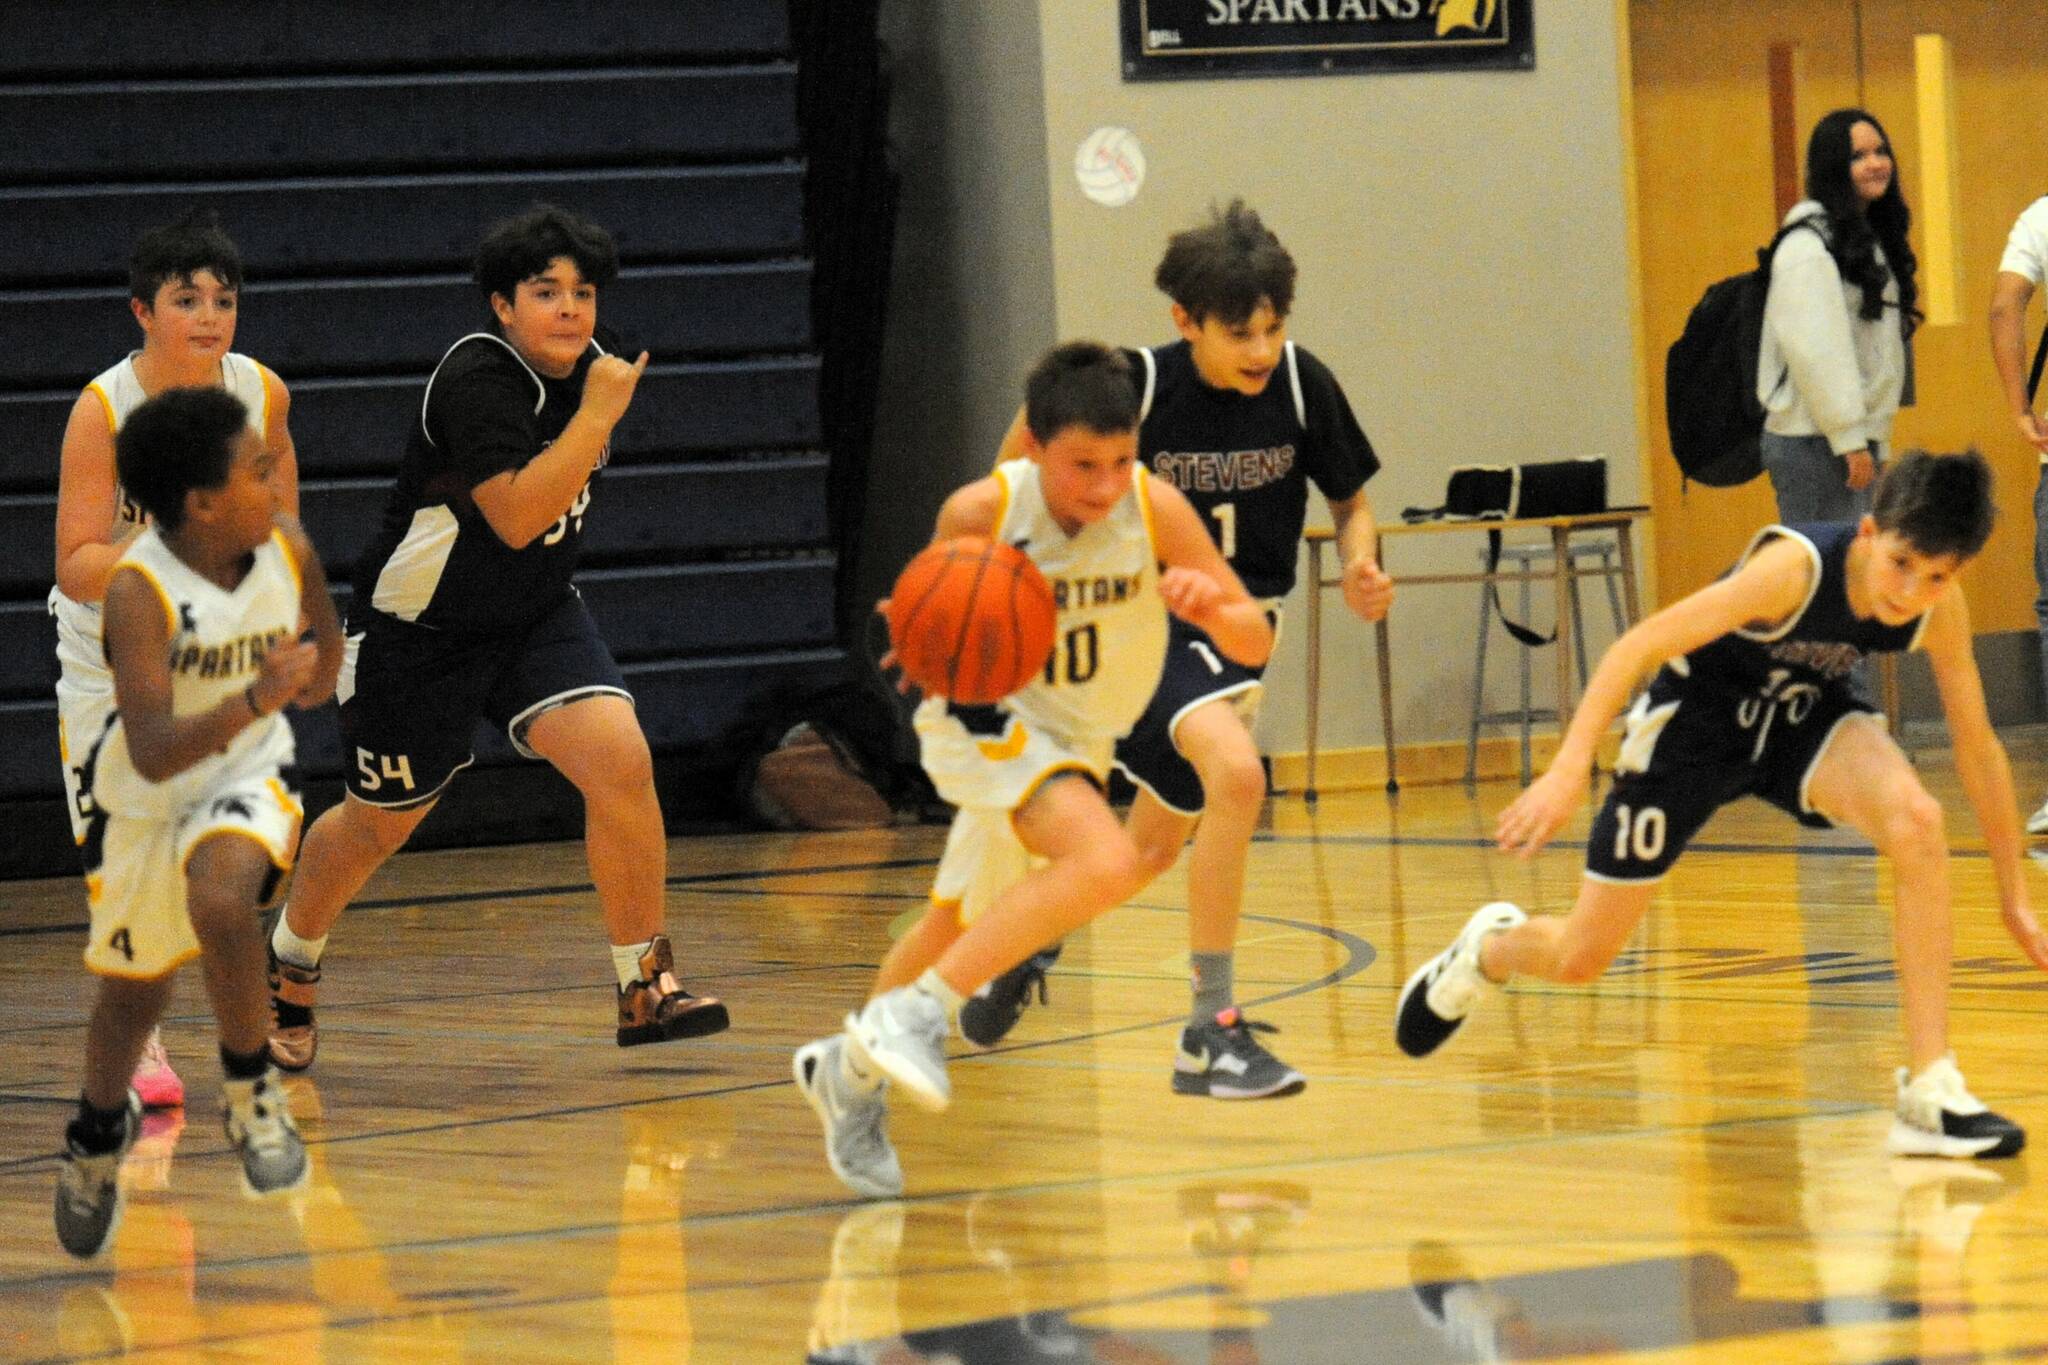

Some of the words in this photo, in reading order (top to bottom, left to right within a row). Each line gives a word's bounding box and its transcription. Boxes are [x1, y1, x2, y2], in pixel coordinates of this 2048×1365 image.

[1153, 443, 1295, 492] STEVENS
[1211, 503, 1236, 559] 1
[1188, 640, 1224, 676] 1
[356, 745, 416, 792] 54
[1614, 804, 1667, 862] 10
[109, 926, 133, 962] 4
